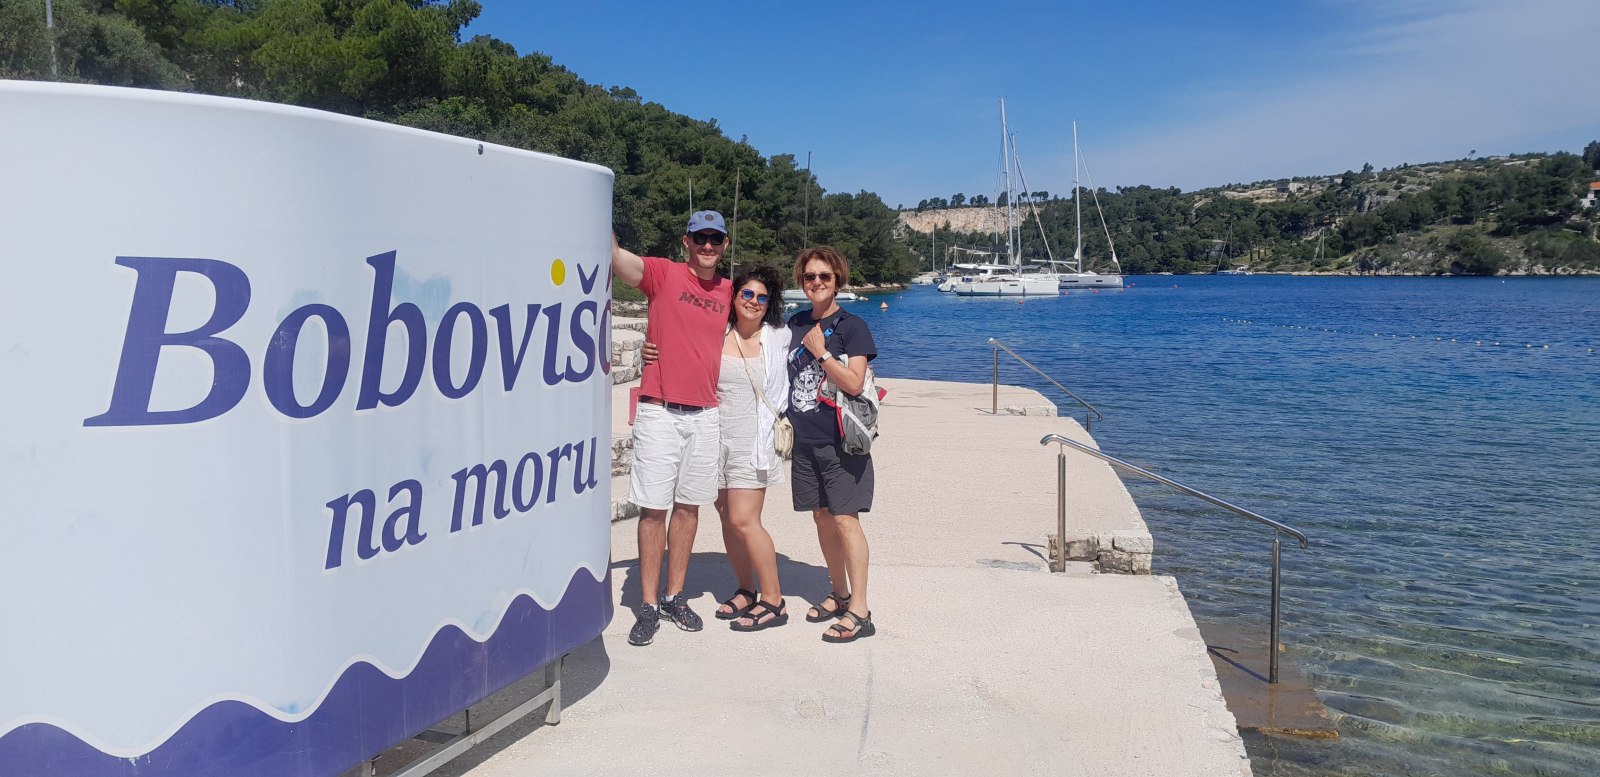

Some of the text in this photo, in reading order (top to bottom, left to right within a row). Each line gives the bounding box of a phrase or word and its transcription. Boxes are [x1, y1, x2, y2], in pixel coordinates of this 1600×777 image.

[679, 291, 725, 314] MCFLY
[324, 437, 598, 570] na moru
